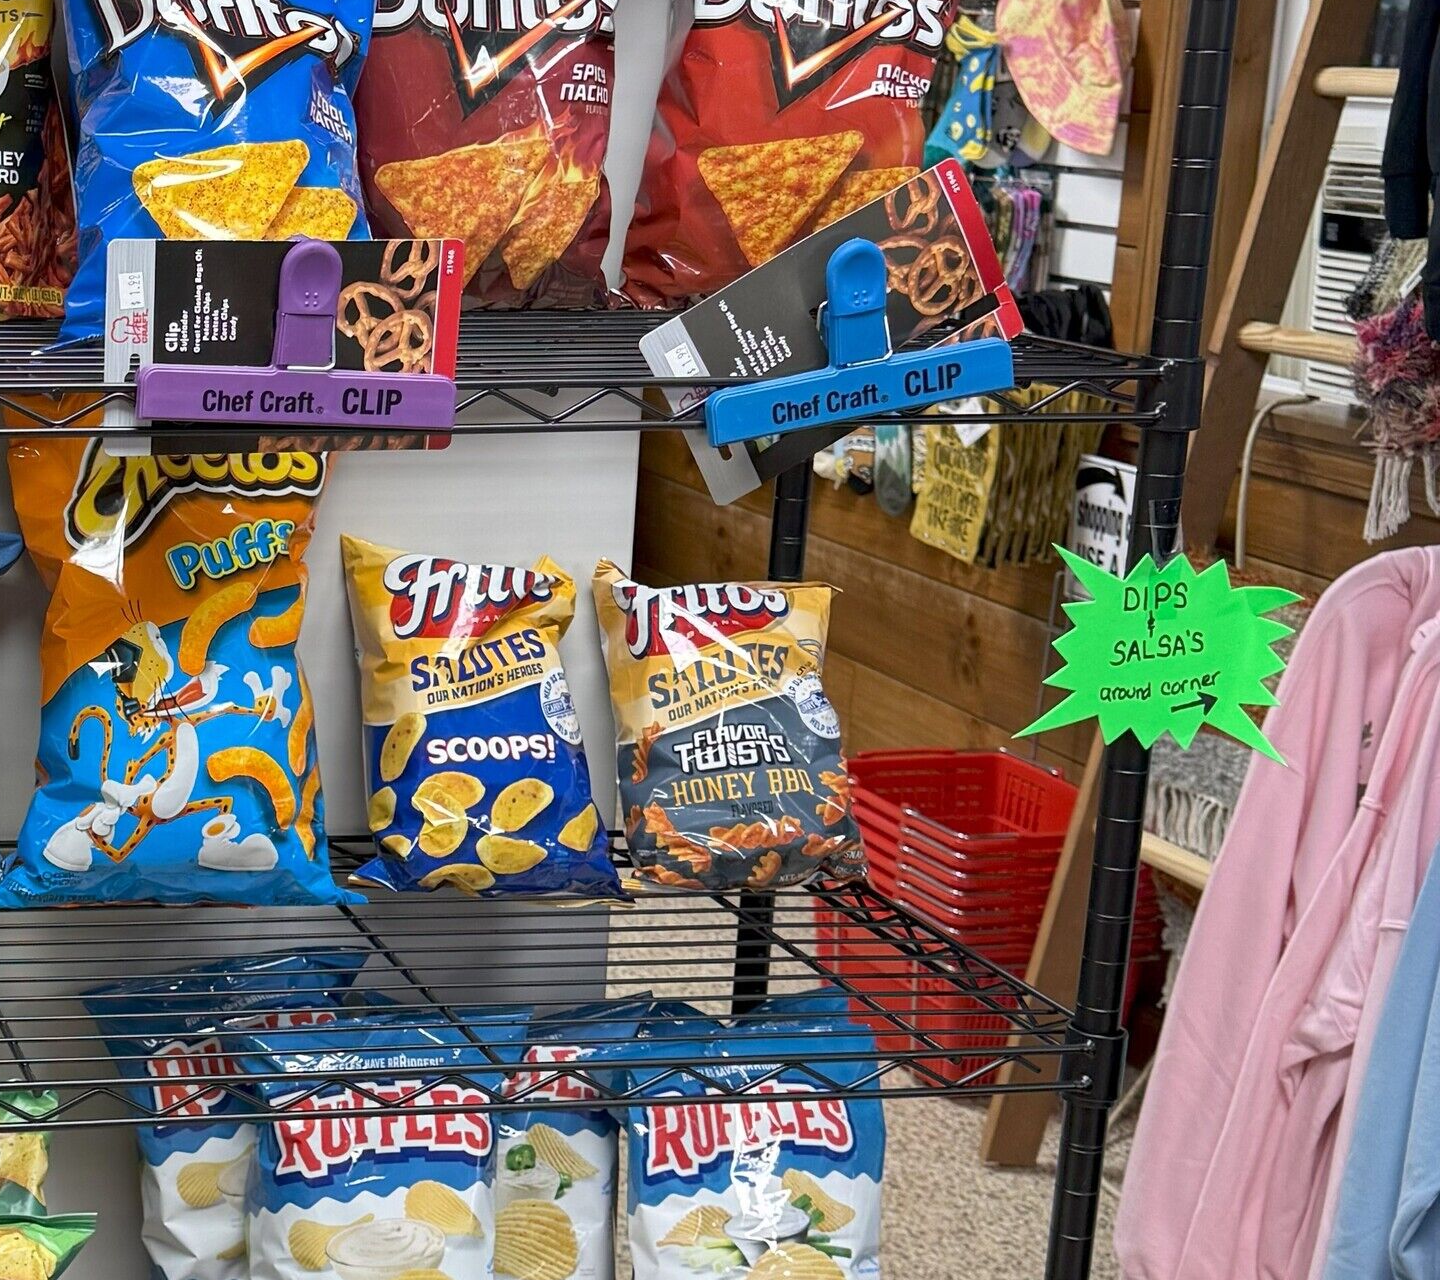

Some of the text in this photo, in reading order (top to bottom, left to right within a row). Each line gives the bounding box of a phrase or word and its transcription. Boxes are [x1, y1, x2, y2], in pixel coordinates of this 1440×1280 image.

[572, 63, 606, 84] SPICY
[877, 63, 931, 93] NACHO
[560, 83, 608, 104] NACHO
[164, 322, 181, 352] Clip
[180, 309, 190, 353] Sujetador
[211, 309, 220, 341] Pretzels
[229, 316, 239, 341] Candy
[201, 388, 403, 415] Chef Craft CLIP
[771, 362, 962, 425] Chef Craft CLIP
[169, 520, 294, 588] Puffs
[1123, 582, 1188, 611] DIPS
[410, 628, 547, 692] SALUTES
[1109, 629, 1205, 666] SALSA'S
[427, 662, 544, 706] OUR NATION'S HEROES
[647, 642, 789, 710] SALUTES
[1100, 670, 1221, 701] around corner
[668, 680, 749, 722] OUR NATION'S
[427, 734, 556, 764] SCOOPS!
[674, 734, 792, 770] TWISTS
[693, 724, 767, 748] FLAVOR
[672, 768, 815, 806] HONEY BBQ
[731, 800, 775, 818] FLAVORED
[278, 1086, 491, 1173] RUFFLES
[650, 1087, 848, 1177] RUFFLES
